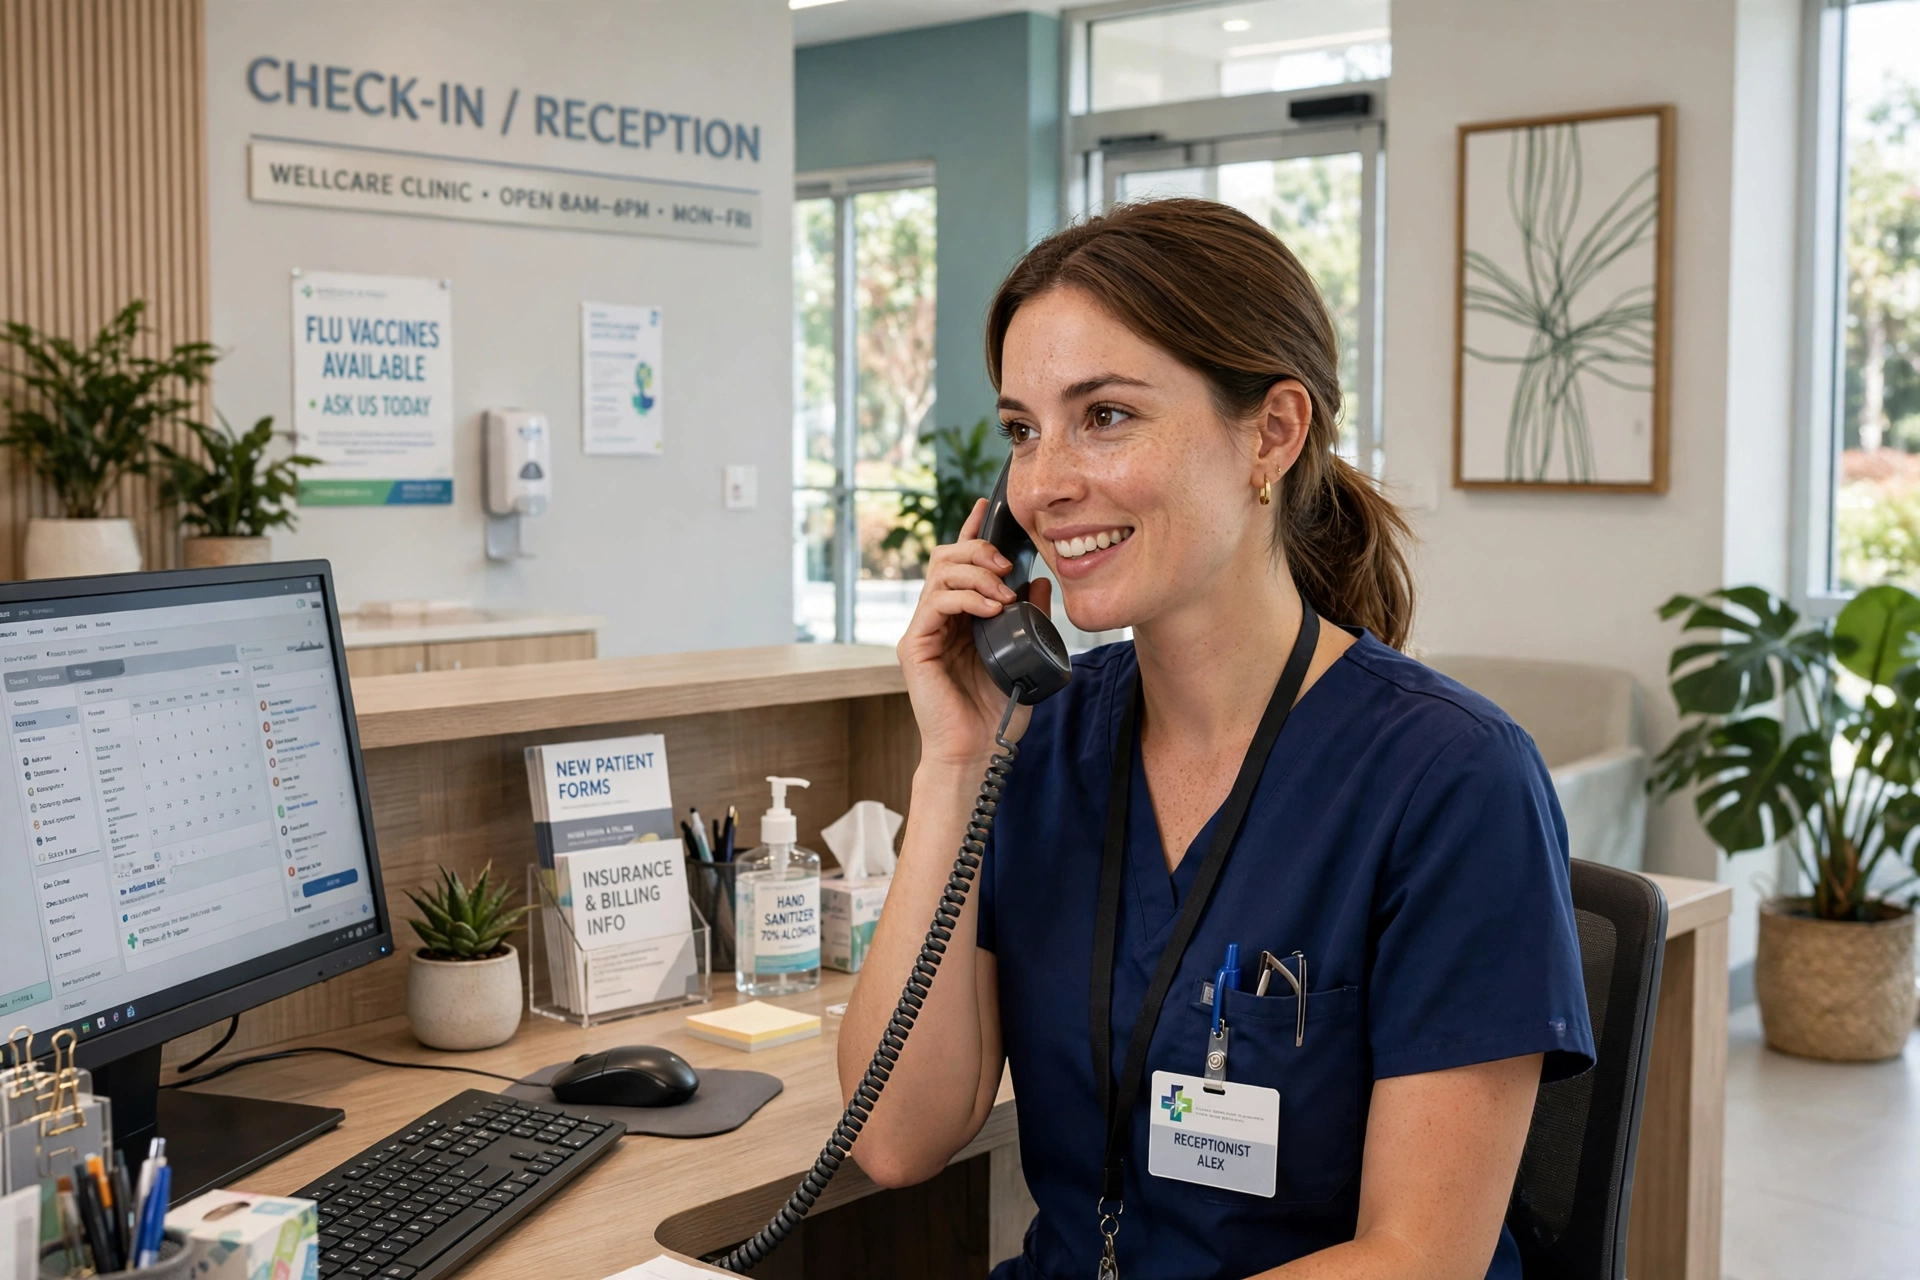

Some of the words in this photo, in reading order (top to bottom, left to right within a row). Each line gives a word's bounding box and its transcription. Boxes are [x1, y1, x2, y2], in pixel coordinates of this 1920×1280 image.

[247, 57, 484, 129] CHECK-IN
[535, 94, 760, 163] RECEPTION
[269, 162, 393, 195] WELLCARE
[400, 176, 472, 202] CLINIC
[499, 186, 553, 211] OPEN
[306, 316, 342, 343] FLU
[348, 318, 439, 348] VACCINES
[322, 351, 426, 381] AVAILABLE
[322, 394, 353, 416] ASK
[357, 395, 378, 417] US
[382, 395, 432, 417] TODAY
[556, 759, 591, 778] NEW
[595, 752, 654, 774] PATIENT
[558, 778, 611, 800] FORMS
[583, 860, 674, 888] INSURANCE
[585, 894, 597, 912] &
[601, 885, 661, 910] BILLING
[777, 894, 805, 909] HAND
[587, 914, 625, 936] INFO
[764, 908, 815, 926] SANITIZER
[761, 929, 780, 941] 70%
[1174, 1132, 1251, 1158] RECEPTIONIST
[1197, 1154, 1225, 1171] ALEX
